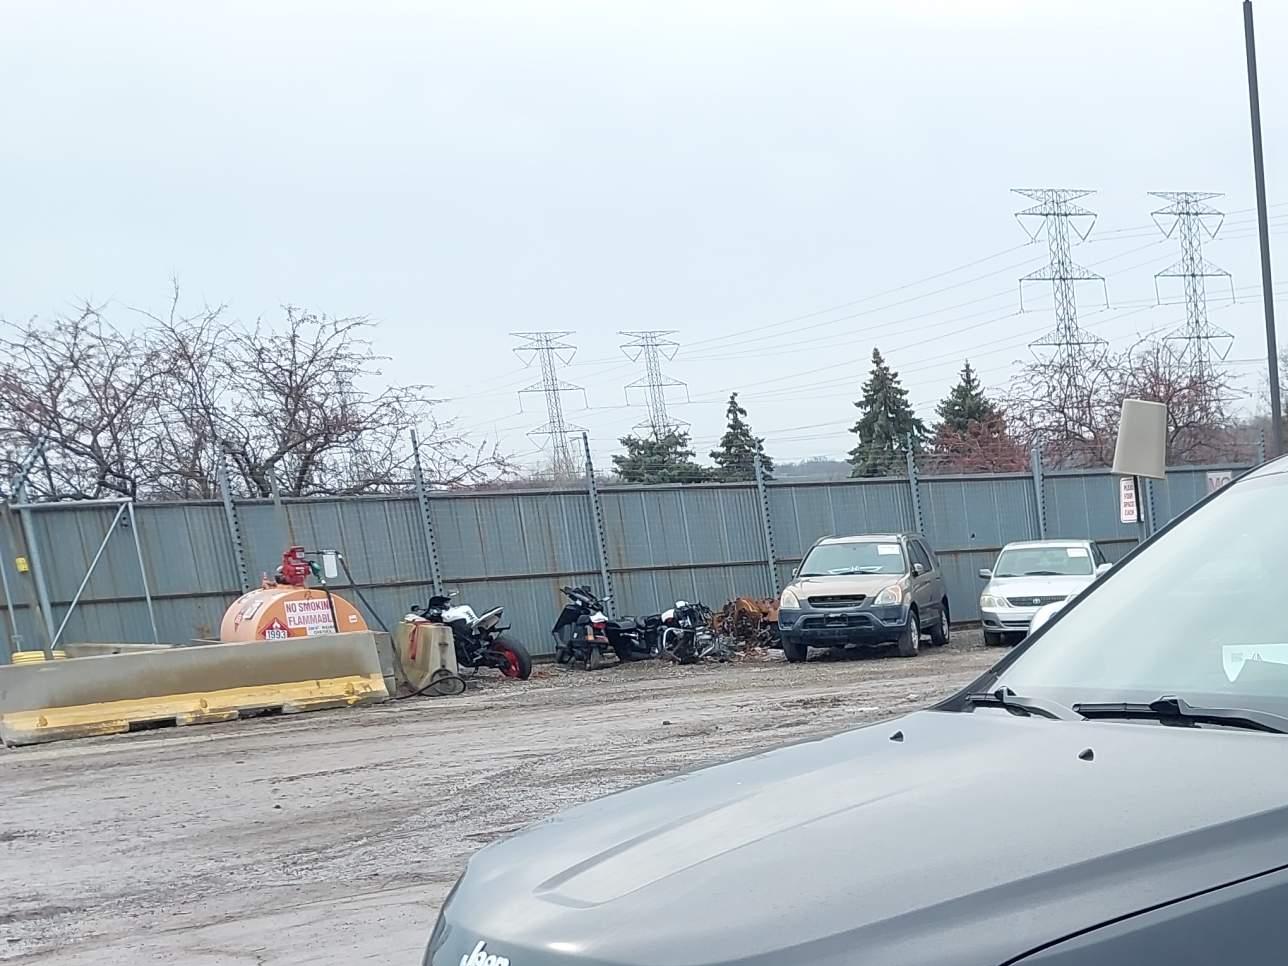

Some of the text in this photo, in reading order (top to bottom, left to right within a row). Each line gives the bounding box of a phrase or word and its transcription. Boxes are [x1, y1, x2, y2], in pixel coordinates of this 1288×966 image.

[286, 600, 331, 613] NO SMOKIN
[288, 614, 333, 626] FLAMMABL
[267, 631, 286, 639] 1993
